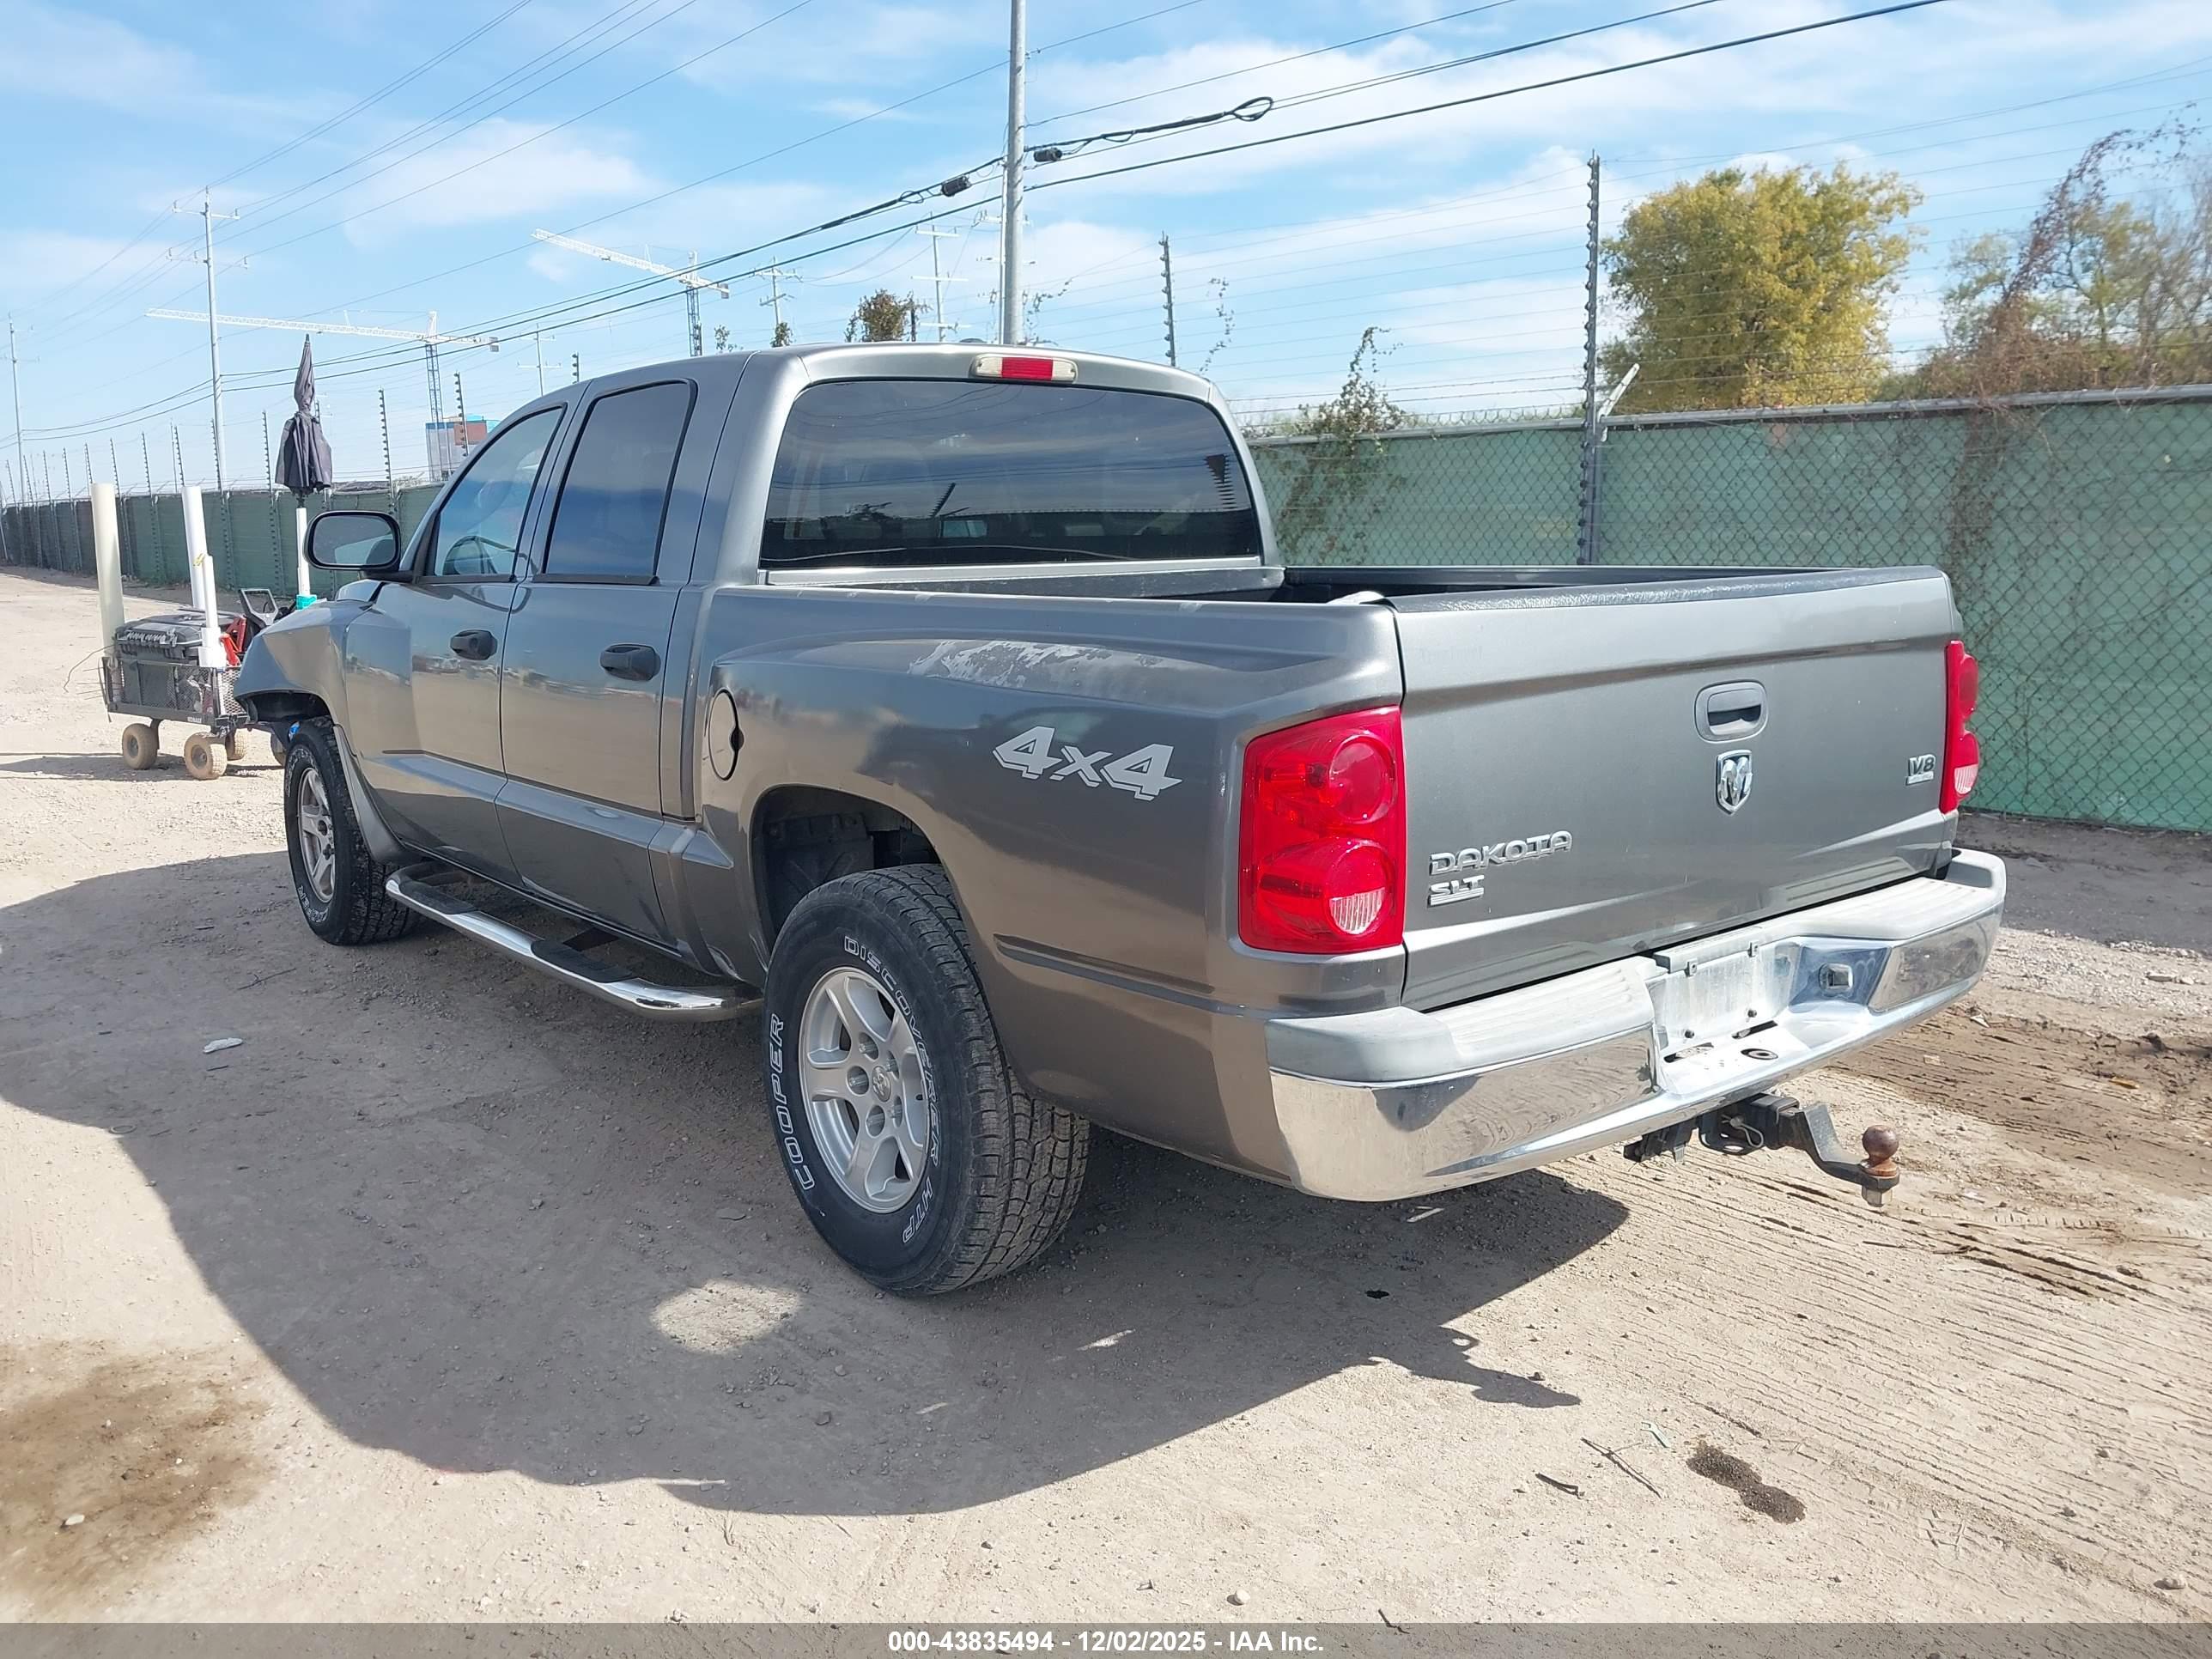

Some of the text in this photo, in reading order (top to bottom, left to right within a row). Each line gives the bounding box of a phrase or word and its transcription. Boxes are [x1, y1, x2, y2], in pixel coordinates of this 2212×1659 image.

[993, 726, 1183, 802] 4x4
[1908, 754, 1936, 776] V8
[1429, 830, 1573, 875] DAKOTA
[1429, 874, 1485, 897] SLT
[844, 935, 940, 1168] DISCOVERER
[769, 1013, 816, 1191] COOPER
